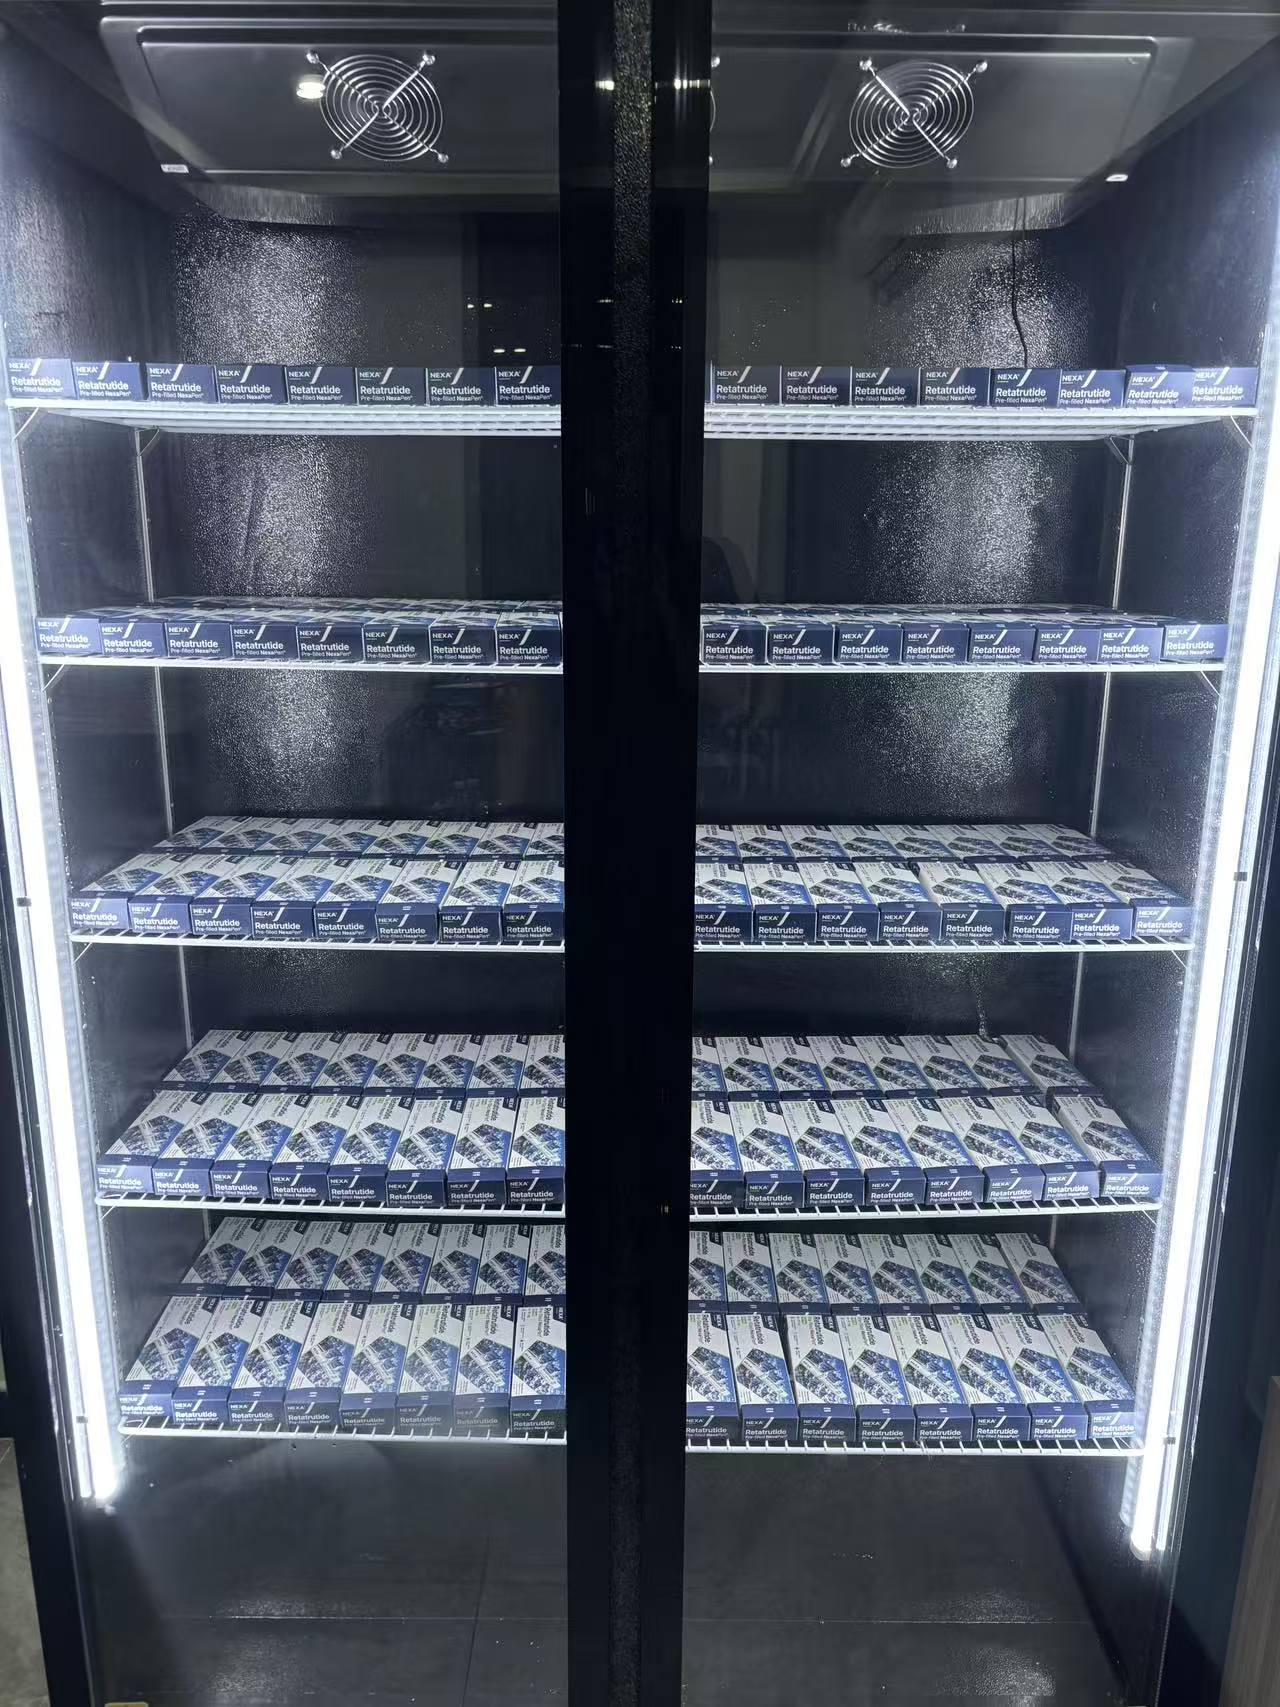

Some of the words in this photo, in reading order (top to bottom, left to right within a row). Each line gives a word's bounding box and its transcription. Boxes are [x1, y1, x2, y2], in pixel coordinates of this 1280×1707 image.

[79, 381, 128, 391] Retatrutide
[151, 382, 201, 392] Retatrutide
[221, 384, 270, 394] Retatrutide
[290, 385, 340, 394] Retatrutide
[361, 386, 410, 395] Retatrutide
[431, 386, 481, 395] Retatrutide
[500, 385, 550, 395] Retatrutide
[717, 384, 767, 394] Retatrutide
[787, 385, 837, 394] Retatrutide
[926, 386, 975, 395] Retatrutide
[855, 386, 905, 396] Retatrutide
[996, 388, 1046, 397] Retatrutide
[1061, 389, 1110, 398] Retatrutide
[1128, 390, 1178, 399] Retatrutide
[104, 639, 152, 648] Retatrutide
[170, 640, 218, 648] Retatrutide
[235, 641, 283, 650] Retatrutide
[301, 643, 349, 651] Retatrutide
[367, 644, 415, 653] Retatrutide
[433, 646, 481, 654] Retatrutide
[500, 646, 547, 655] Retatrutide
[706, 646, 753, 654] Retatrutide
[773, 646, 820, 655] Retatrutide
[841, 645, 888, 654] Retatrutide
[907, 645, 954, 654] Retatrutide
[973, 645, 1020, 654] Retatrutide
[1040, 645, 1086, 654] Retatrutide
[1102, 644, 1149, 653] Retatrutide
[133, 918, 178, 926] Retatrutide
[195, 919, 239, 927] Retatrutide
[318, 923, 364, 931] Retatrutide
[380, 927, 425, 935] Retatrutide
[443, 926, 488, 934] Retatrutide
[696, 926, 740, 934] Retatrutide
[821, 926, 866, 934] Retatrutide
[883, 925, 928, 933] Retatrutide
[946, 925, 992, 933] Retatrutide
[1014, 926, 1059, 934] Retatrutide
[1074, 924, 1119, 932] Retatrutide
[1048, 1185, 1088, 1193] Retatrutide
